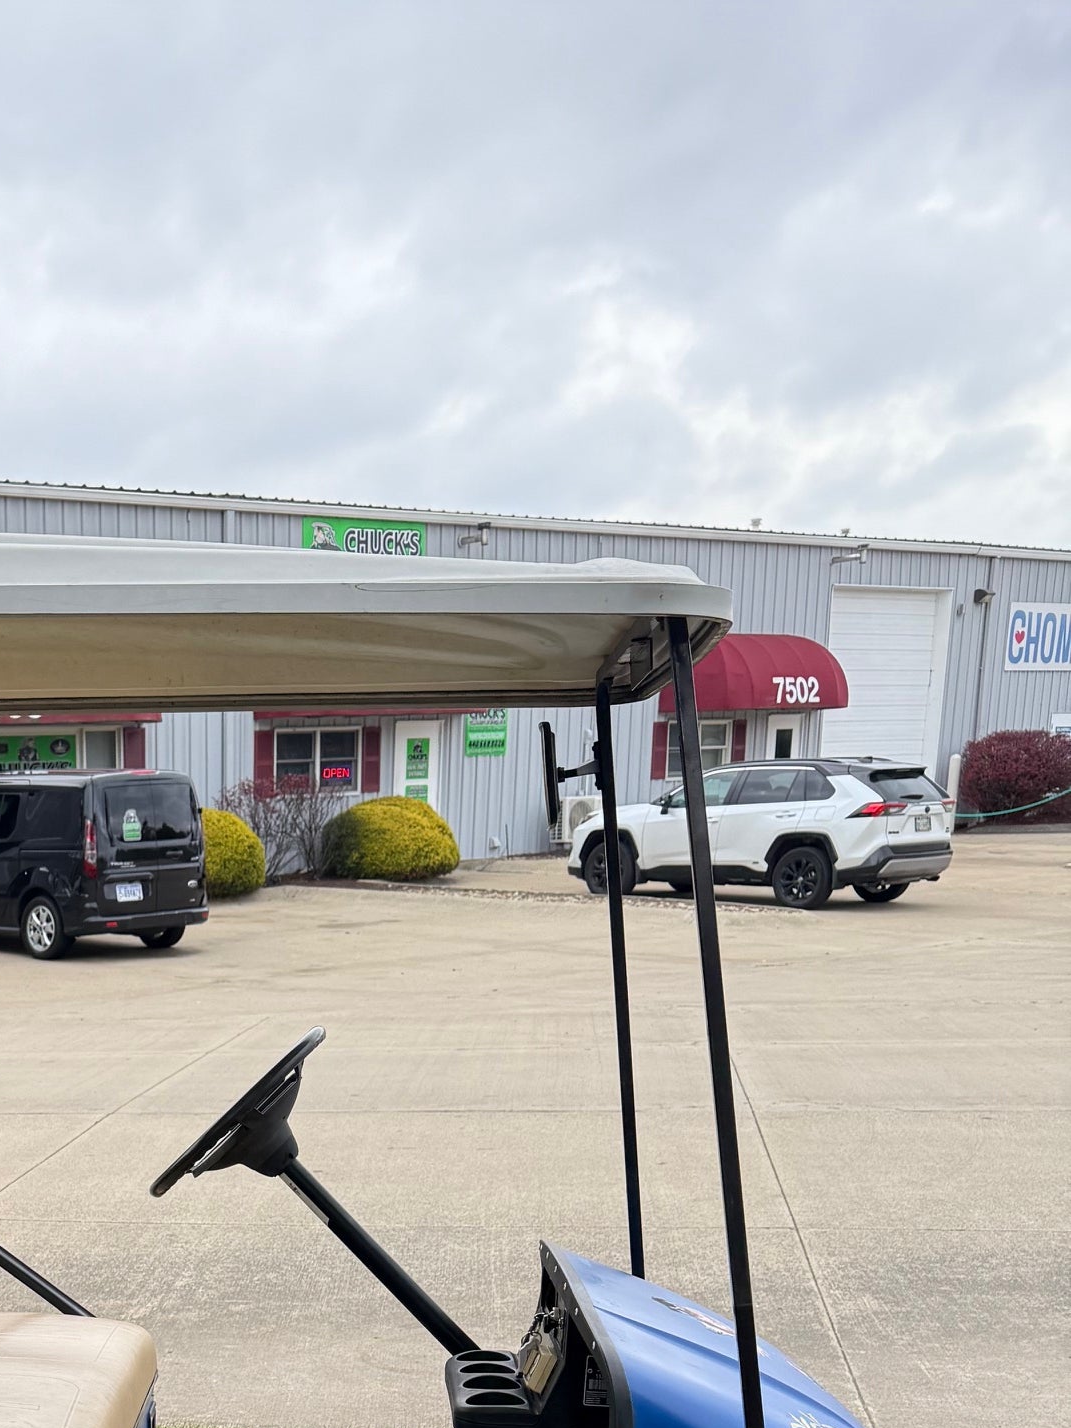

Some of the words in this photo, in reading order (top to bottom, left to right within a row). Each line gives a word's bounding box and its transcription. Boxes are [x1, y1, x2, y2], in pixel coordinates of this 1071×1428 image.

[344, 527, 420, 556] CHUCK'S
[772, 676, 820, 704] 7502
[322, 767, 350, 779] OPEN
